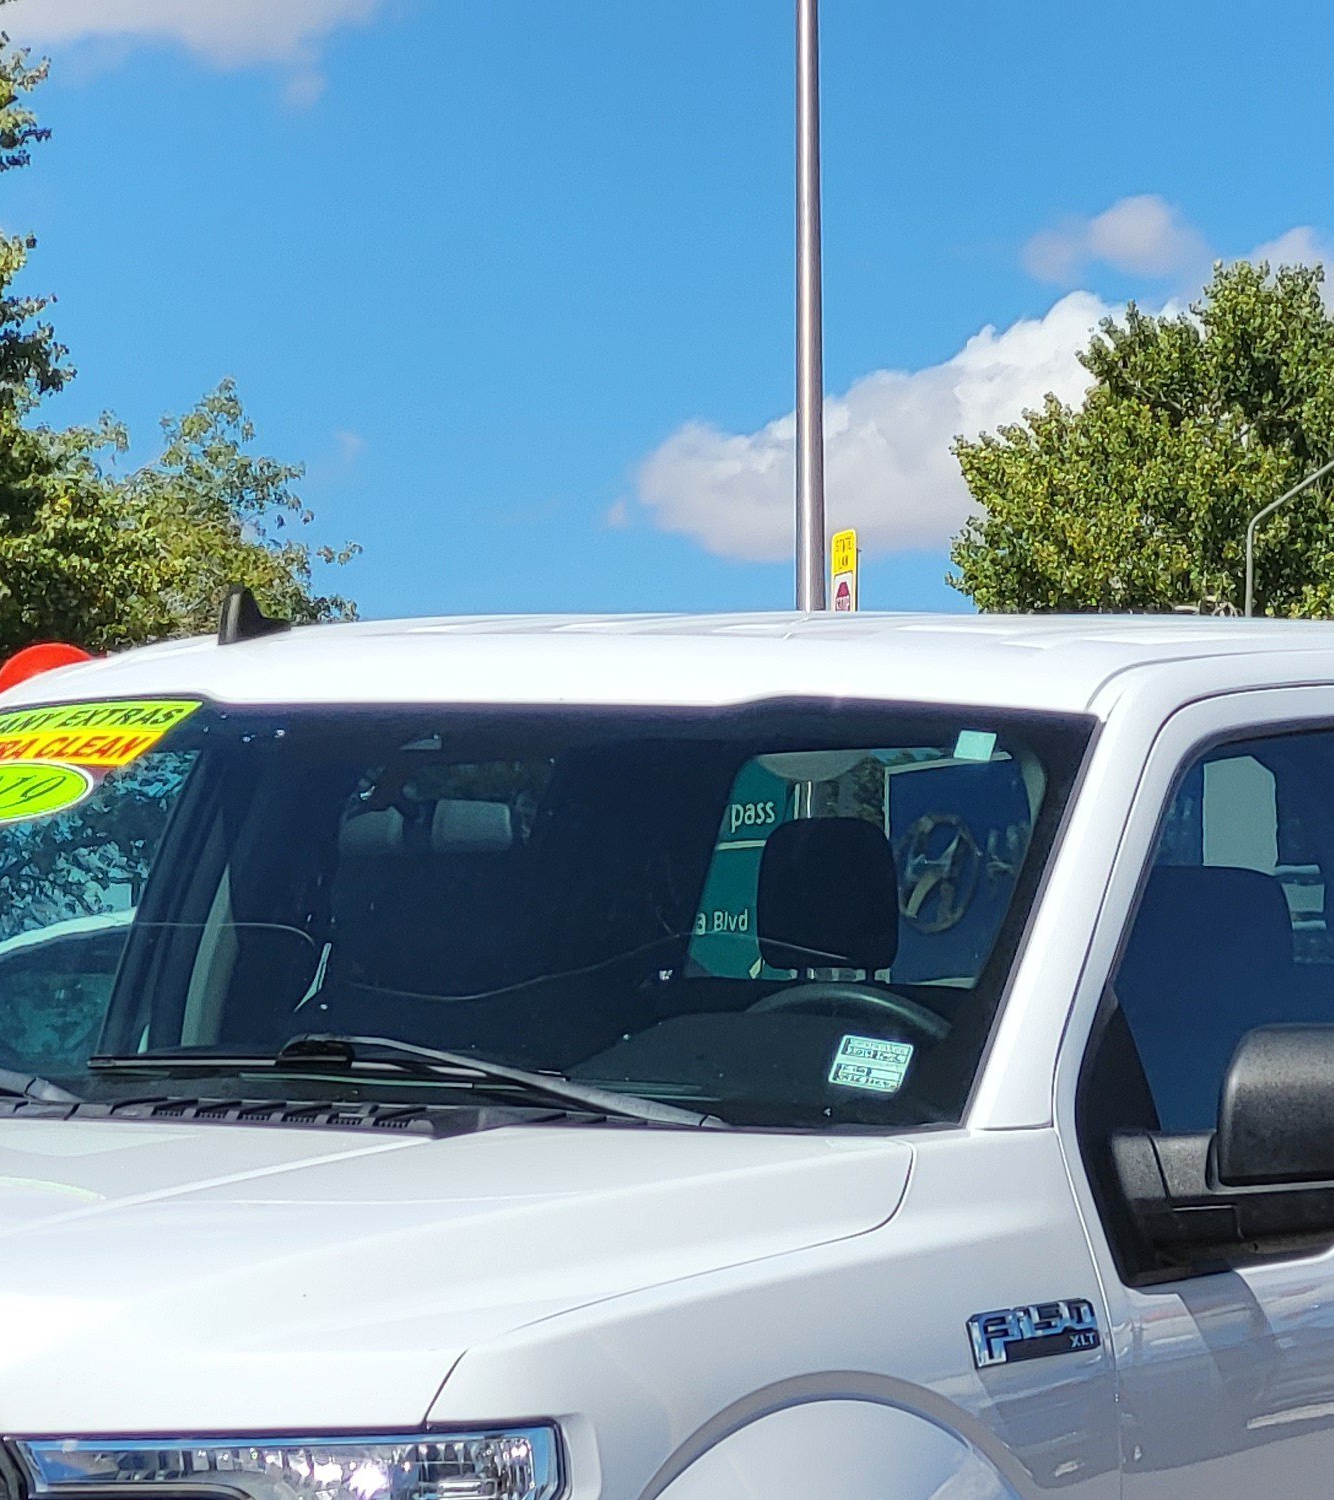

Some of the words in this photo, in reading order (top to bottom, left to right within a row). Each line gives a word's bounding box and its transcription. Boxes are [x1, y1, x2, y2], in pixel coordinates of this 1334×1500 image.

[55, 708, 184, 729] EXTRAS
[33, 736, 152, 760] CLEAN
[713, 908, 748, 932] Blvd
[1069, 1332, 1096, 1349] XLT
